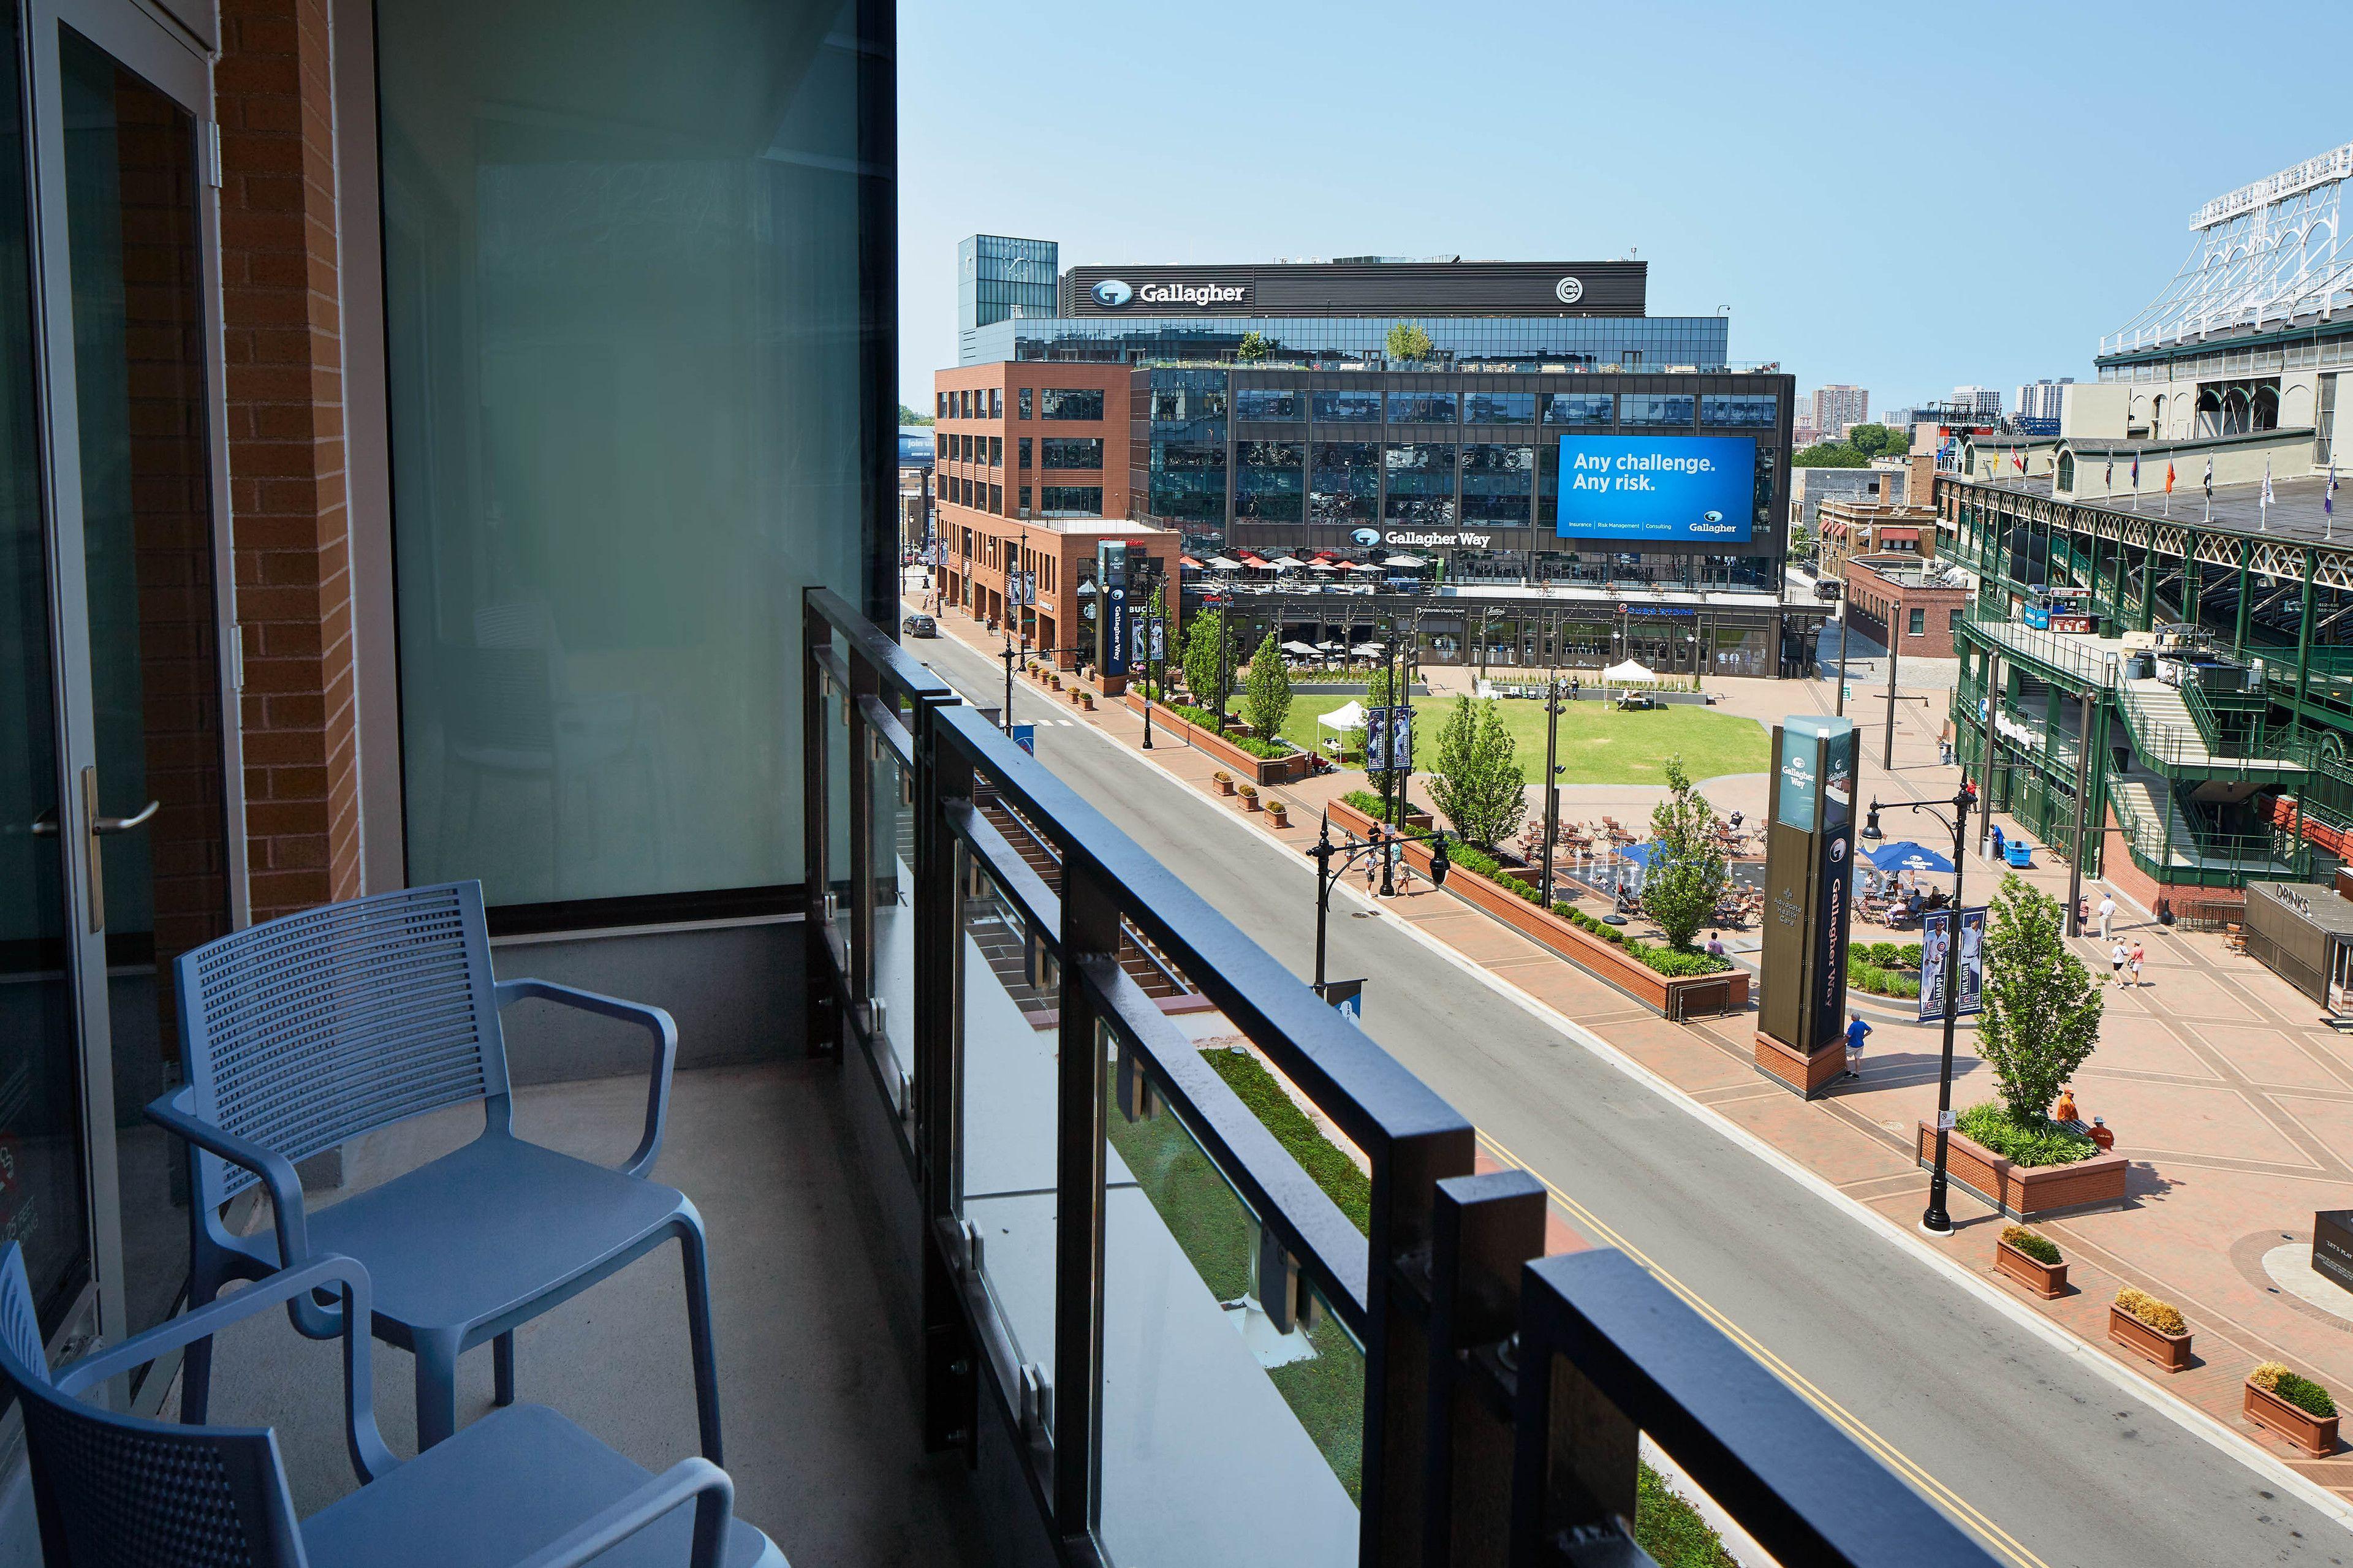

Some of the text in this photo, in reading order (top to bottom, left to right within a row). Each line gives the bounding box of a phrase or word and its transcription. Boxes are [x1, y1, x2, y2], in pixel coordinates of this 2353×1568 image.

[1140, 284, 1245, 306] Gallagher
[1574, 453, 1715, 474] Any challenge.
[1573, 473, 1655, 493] Any risk.
[1689, 523, 1736, 534] Gallagher
[1385, 531, 1491, 548] Gallagher Way
[1782, 765, 1814, 782] Gallagher
[1829, 770, 1848, 782] Gallagher
[1790, 776, 1806, 790] Way
[1774, 897, 1802, 913] Advocate
[2276, 883, 2310, 913] DRINKS
[1778, 906, 1796, 919] Health
[1779, 915, 1794, 926] Care
[1825, 878, 1840, 1007] Gallagher Way
[6, 1215, 17, 1240] 25
[2341, 1249, 2352, 1259] PLAY
